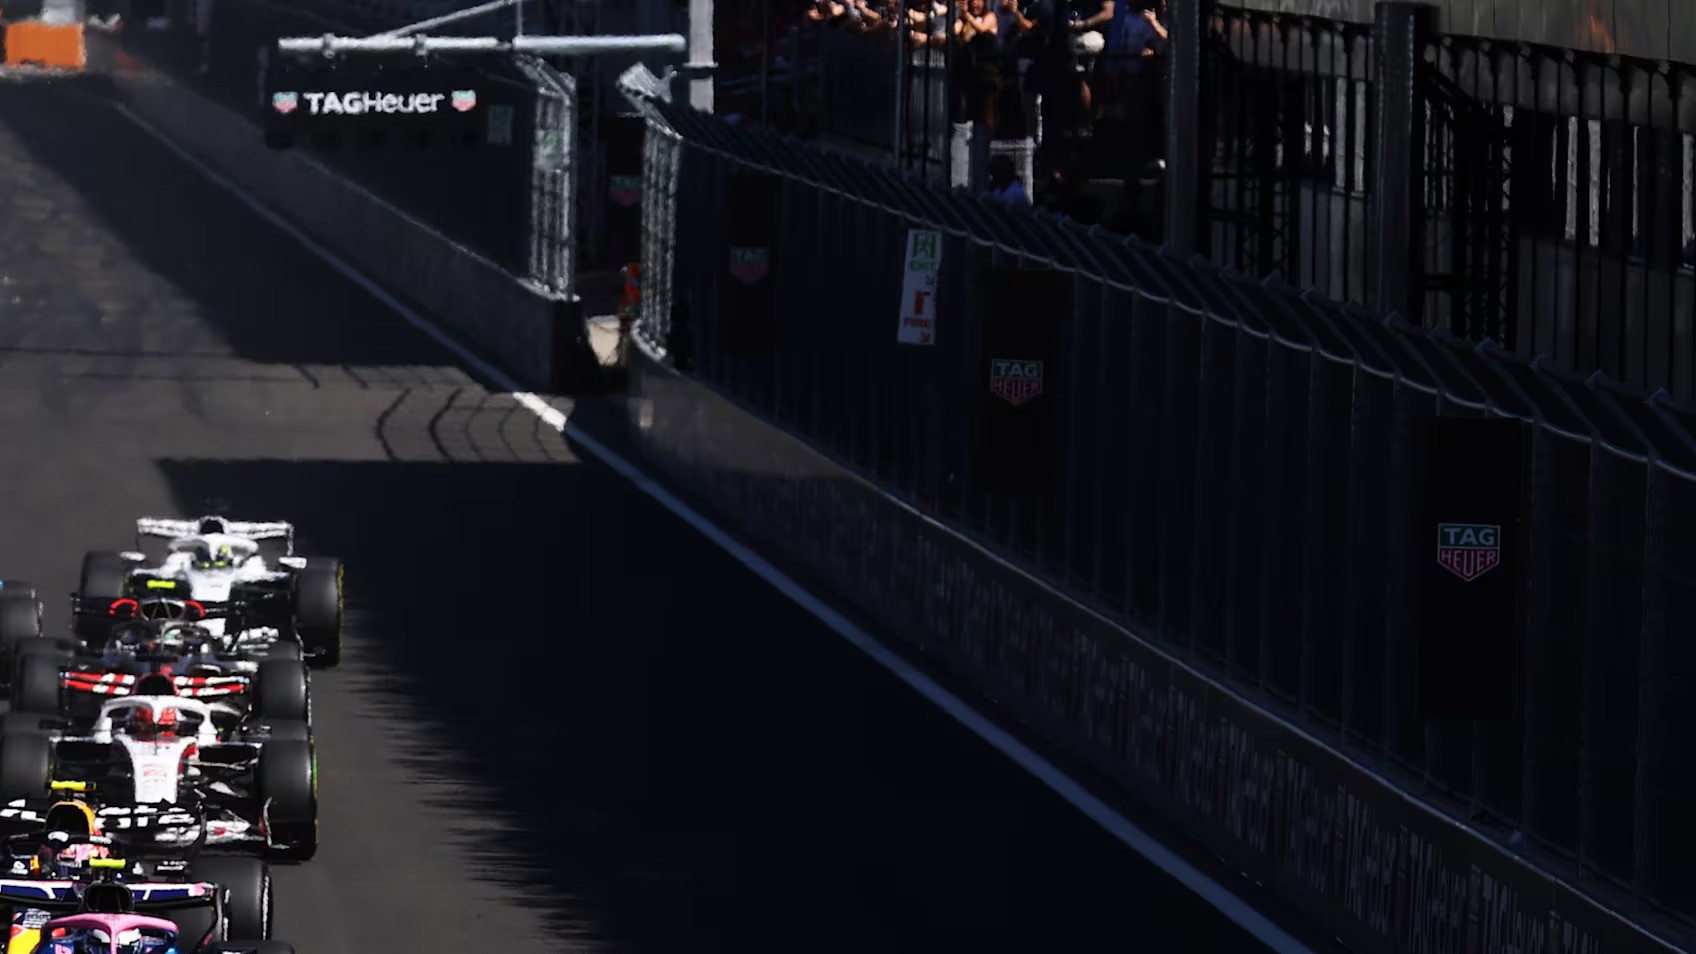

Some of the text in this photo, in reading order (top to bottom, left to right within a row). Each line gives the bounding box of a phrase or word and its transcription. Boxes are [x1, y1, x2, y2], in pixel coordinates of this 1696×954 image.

[996, 362, 1039, 377] TAG
[993, 378, 1041, 402] HEUER
[1443, 527, 1495, 546] TAG
[1440, 549, 1497, 577] HEUER
